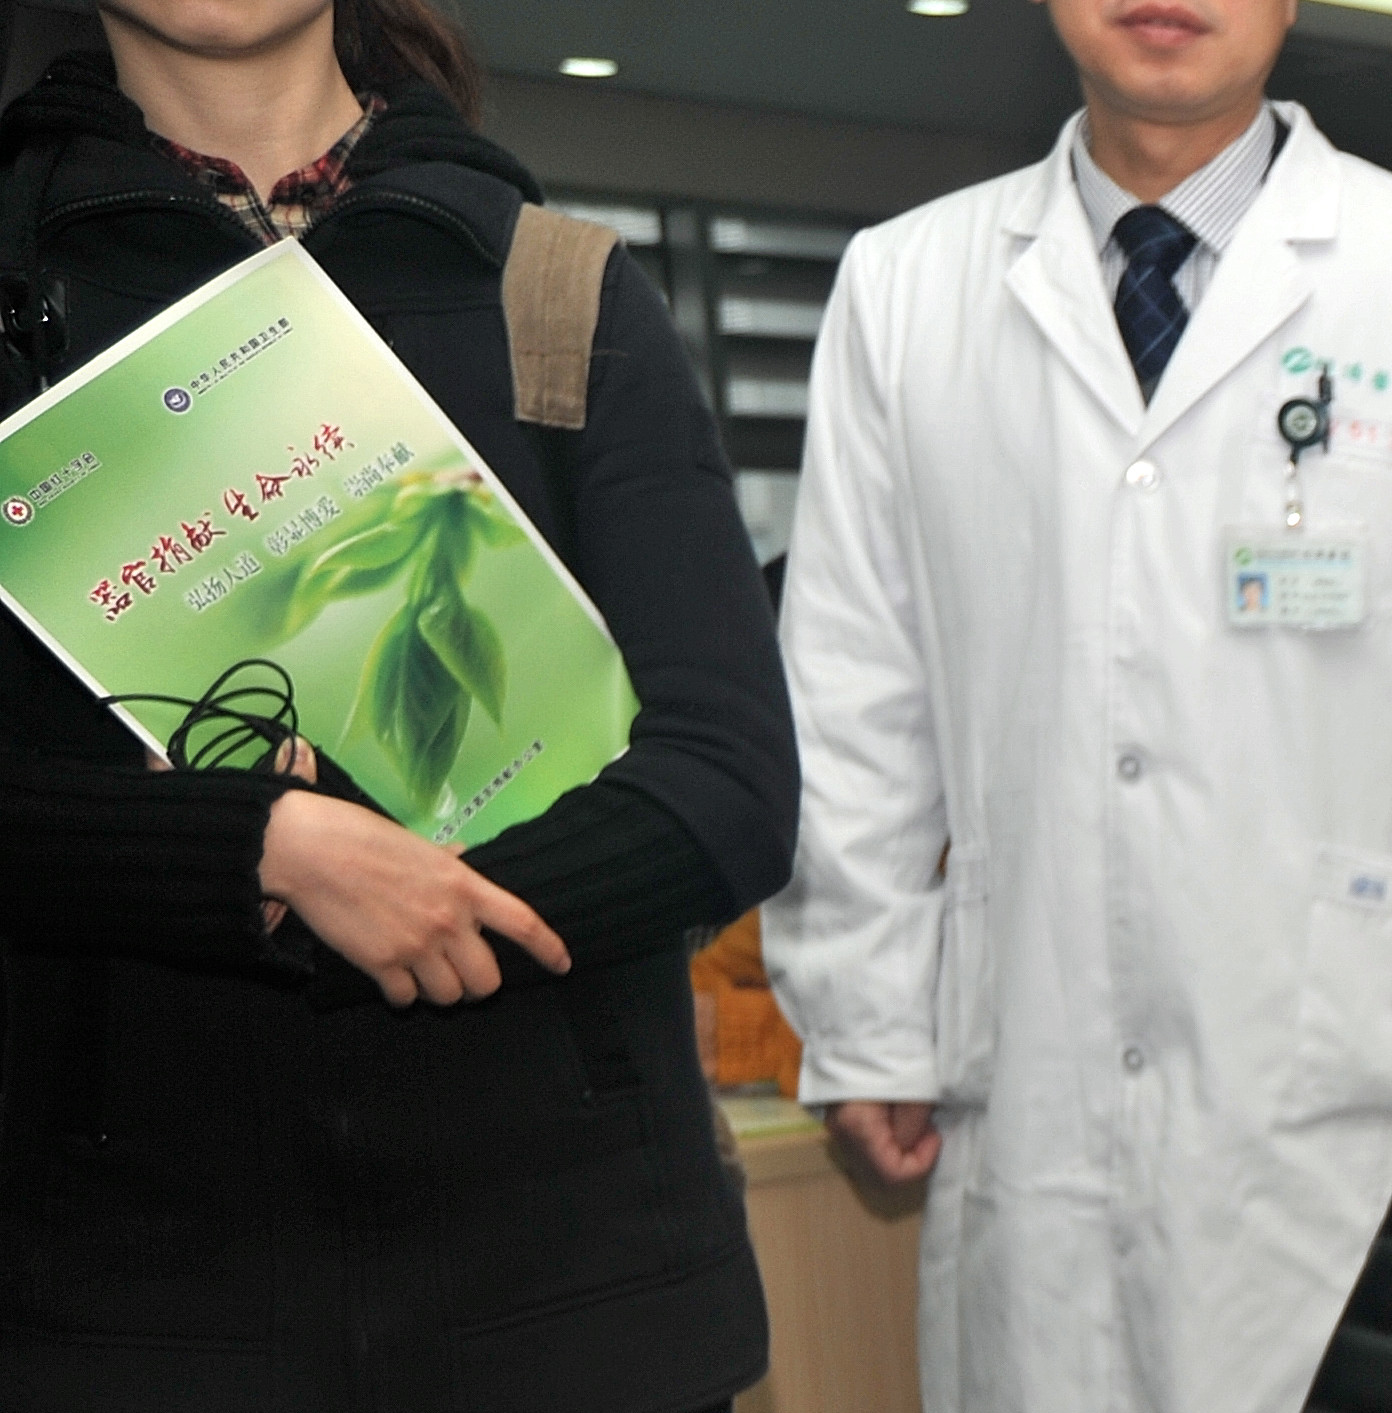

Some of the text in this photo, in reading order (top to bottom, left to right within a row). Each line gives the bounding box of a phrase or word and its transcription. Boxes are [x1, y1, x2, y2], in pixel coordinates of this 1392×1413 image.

[89, 511, 227, 622] 器官捐献
[223, 421, 356, 521] 生命永续
[186, 441, 416, 612] 弘扬人道 彰显博爱 崇尚奉献
